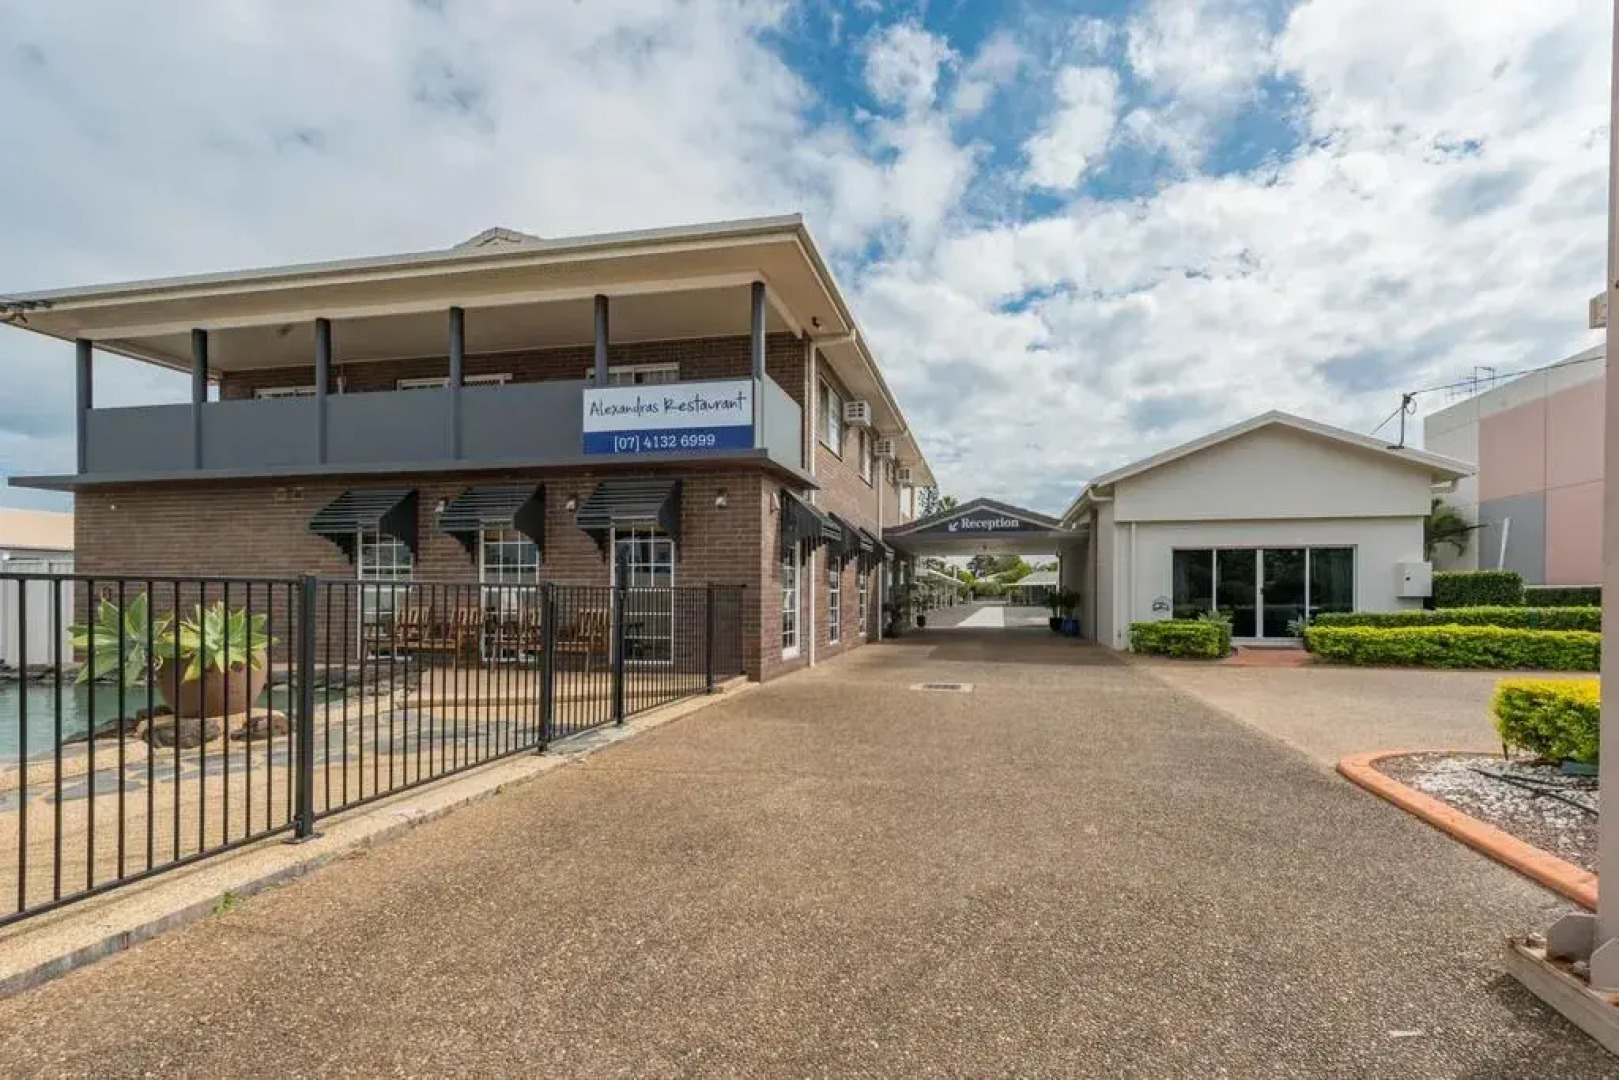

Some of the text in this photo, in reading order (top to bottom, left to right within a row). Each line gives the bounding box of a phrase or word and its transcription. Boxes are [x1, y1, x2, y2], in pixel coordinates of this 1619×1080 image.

[590, 391, 747, 417] Alexandras Restaurant
[643, 435, 676, 448] 4132
[680, 434, 716, 447] 6999
[961, 518, 1019, 531] Reception
